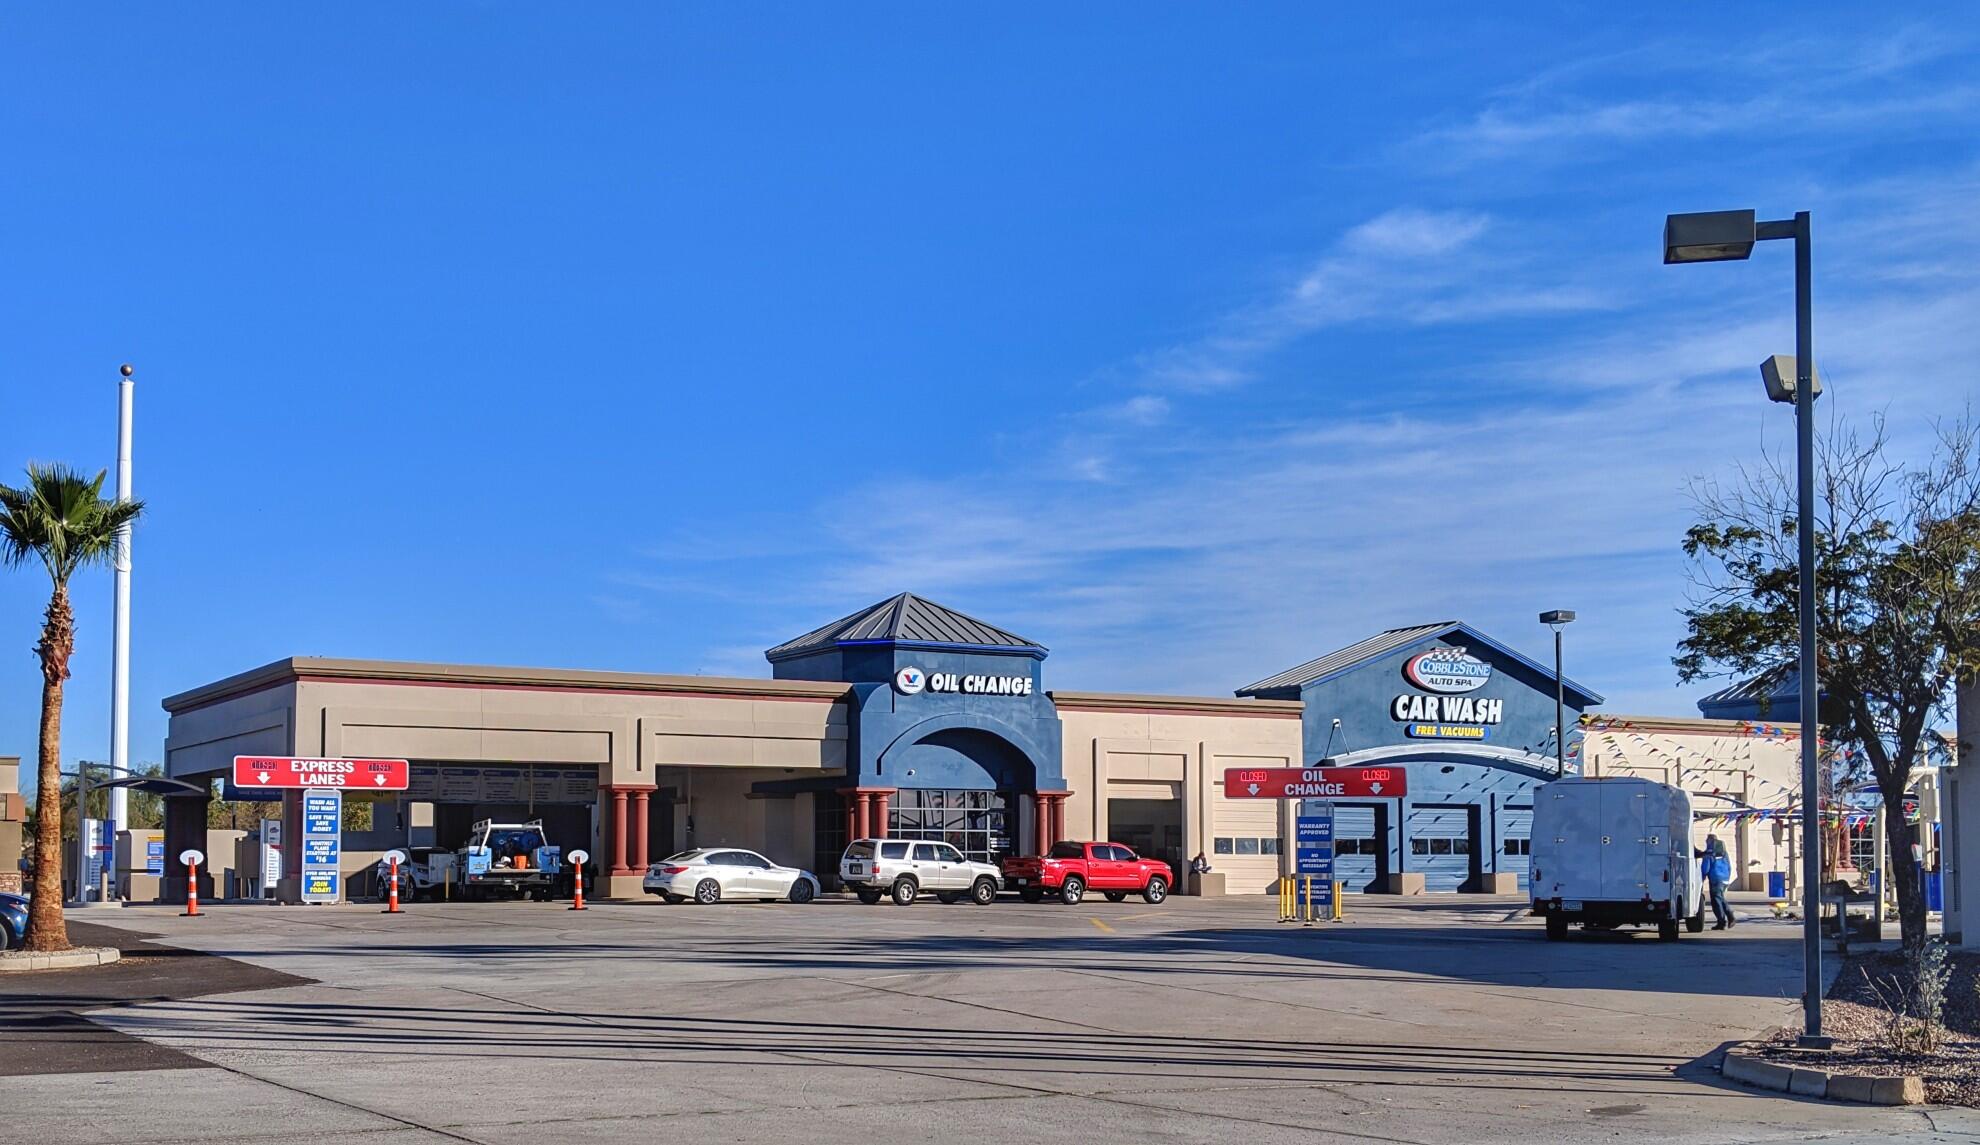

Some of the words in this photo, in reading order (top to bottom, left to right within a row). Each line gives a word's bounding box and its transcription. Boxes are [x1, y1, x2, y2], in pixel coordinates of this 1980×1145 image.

[931, 673, 959, 692] OIL
[964, 675, 1033, 694] CHANGE
[1428, 678, 1453, 686] AUTO
[1455, 679, 1473, 687] SPA
[1396, 695, 1439, 721] CAR
[1443, 697, 1503, 723] WASH
[1416, 726, 1437, 735] FREE
[1440, 727, 1484, 737] VACUUMS
[291, 761, 354, 773] EXPRESS
[300, 774, 345, 785] LANES
[1240, 772, 1267, 781] CLOSED
[1302, 770, 1327, 782] OIL
[1362, 770, 1390, 780] CLOSED
[1284, 784, 1344, 795] CHANGE
